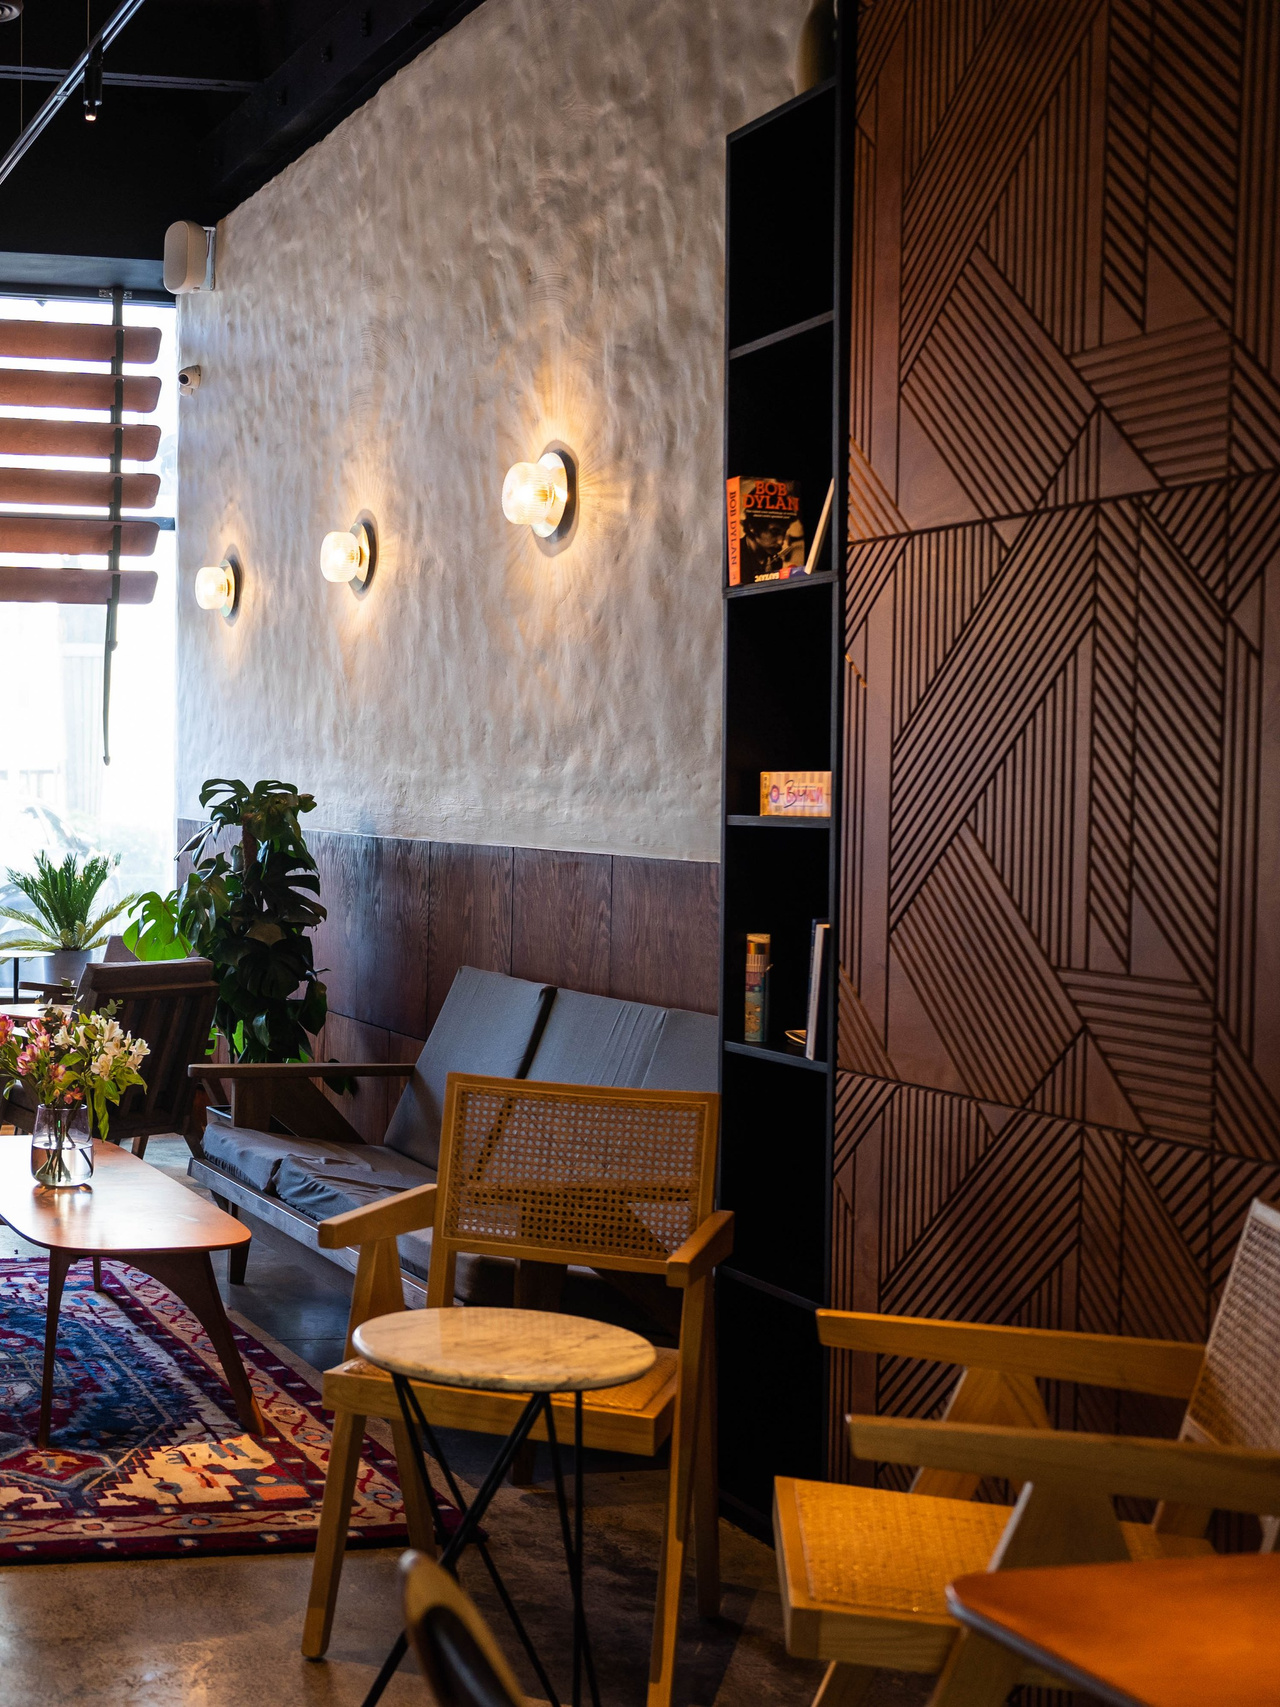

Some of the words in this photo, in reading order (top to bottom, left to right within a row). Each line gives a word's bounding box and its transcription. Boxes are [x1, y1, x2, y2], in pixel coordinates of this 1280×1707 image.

[755, 481, 788, 496] BOB
[729, 491, 737, 517] BOB
[743, 494, 800, 511] DYLAN
[730, 520, 738, 566] DYLAN
